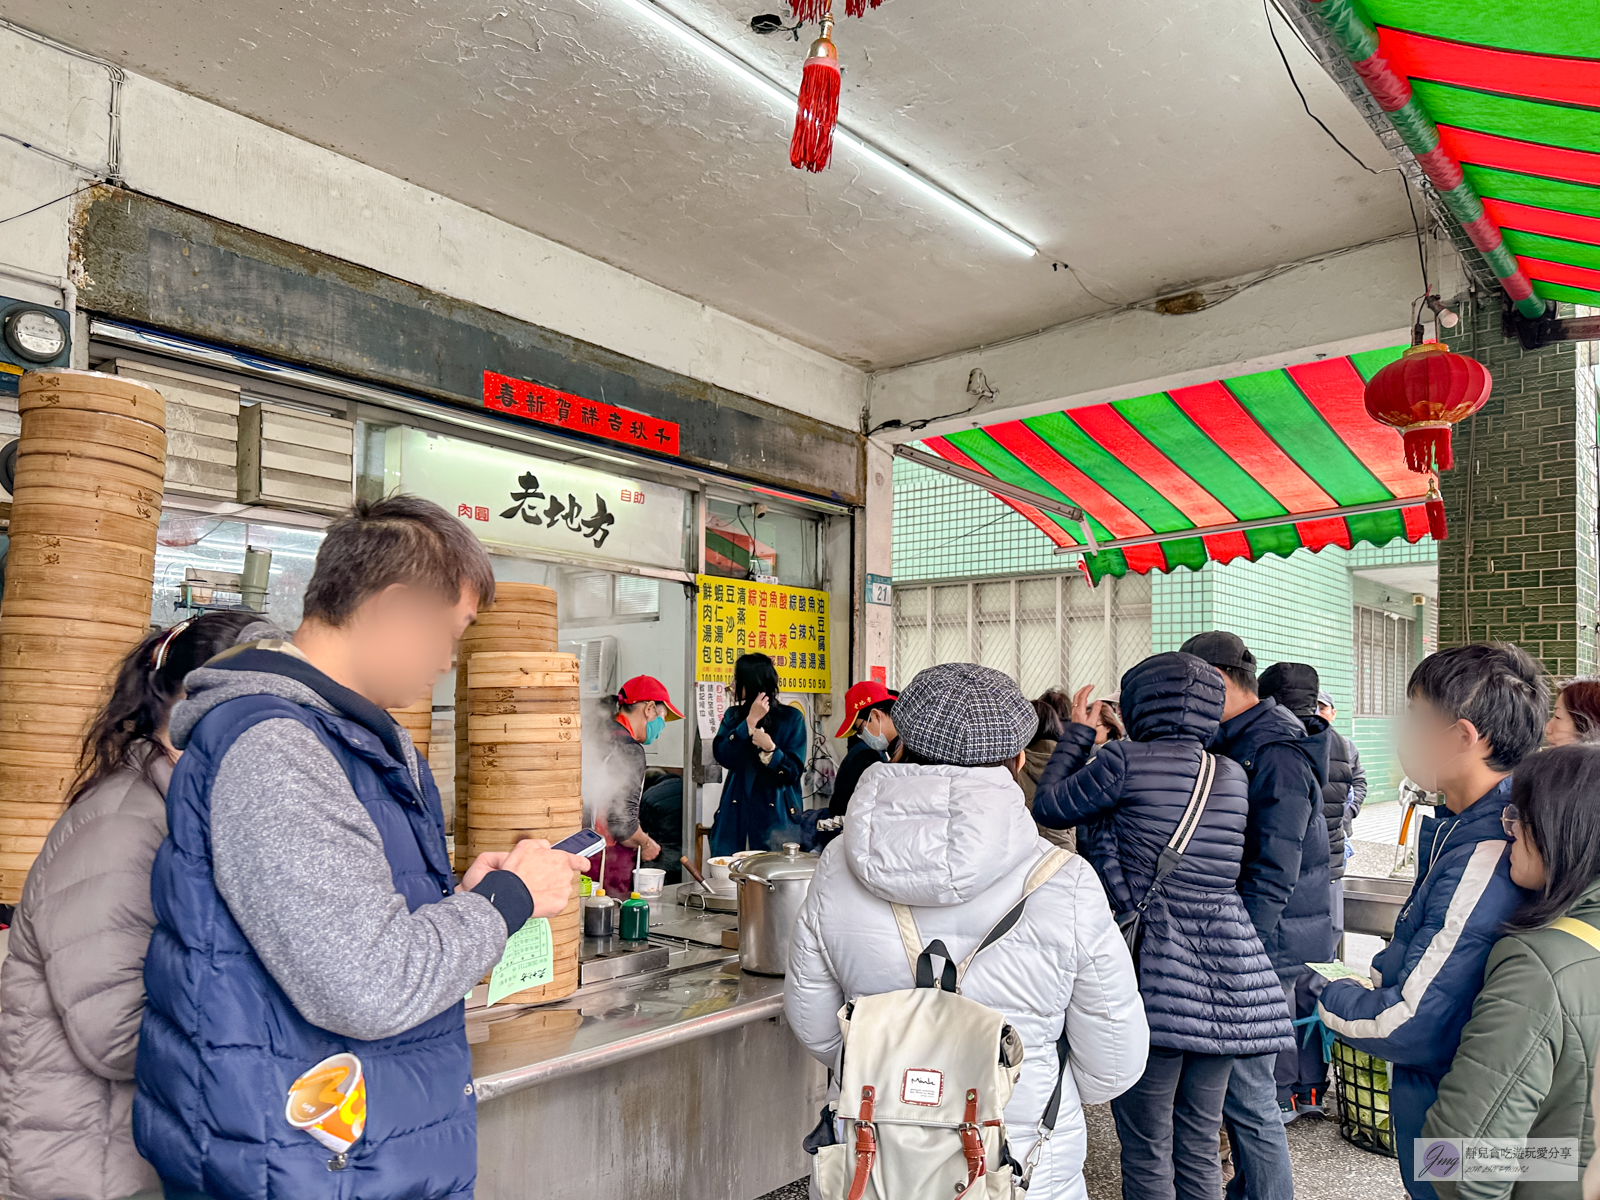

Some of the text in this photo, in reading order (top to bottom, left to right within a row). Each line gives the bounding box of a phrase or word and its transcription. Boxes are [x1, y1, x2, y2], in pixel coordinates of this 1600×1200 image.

[457, 502, 490, 522] 肉圓
[498, 470, 615, 549] 老地方
[620, 488, 645, 505] 自助
[702, 582, 712, 664] 鮮肉湯包
[714, 584, 724, 664] 蝦仁湯包
[725, 585, 735, 665] 豆沙包
[758, 590, 767, 650] 油豆腐
[768, 591, 778, 650] 魚丸
[778, 592, 788, 650] 酸辣
[877, 586, 888, 602] 21
[798, 594, 807, 669] 酸辣湯
[807, 596, 816, 670] 魚丸湯
[816, 597, 826, 671] 油豆腐湯
[778, 677, 787, 688] 60
[788, 677, 797, 688] 60
[798, 678, 807, 688] 50
[808, 678, 817, 689] 50
[818, 679, 827, 689] 50
